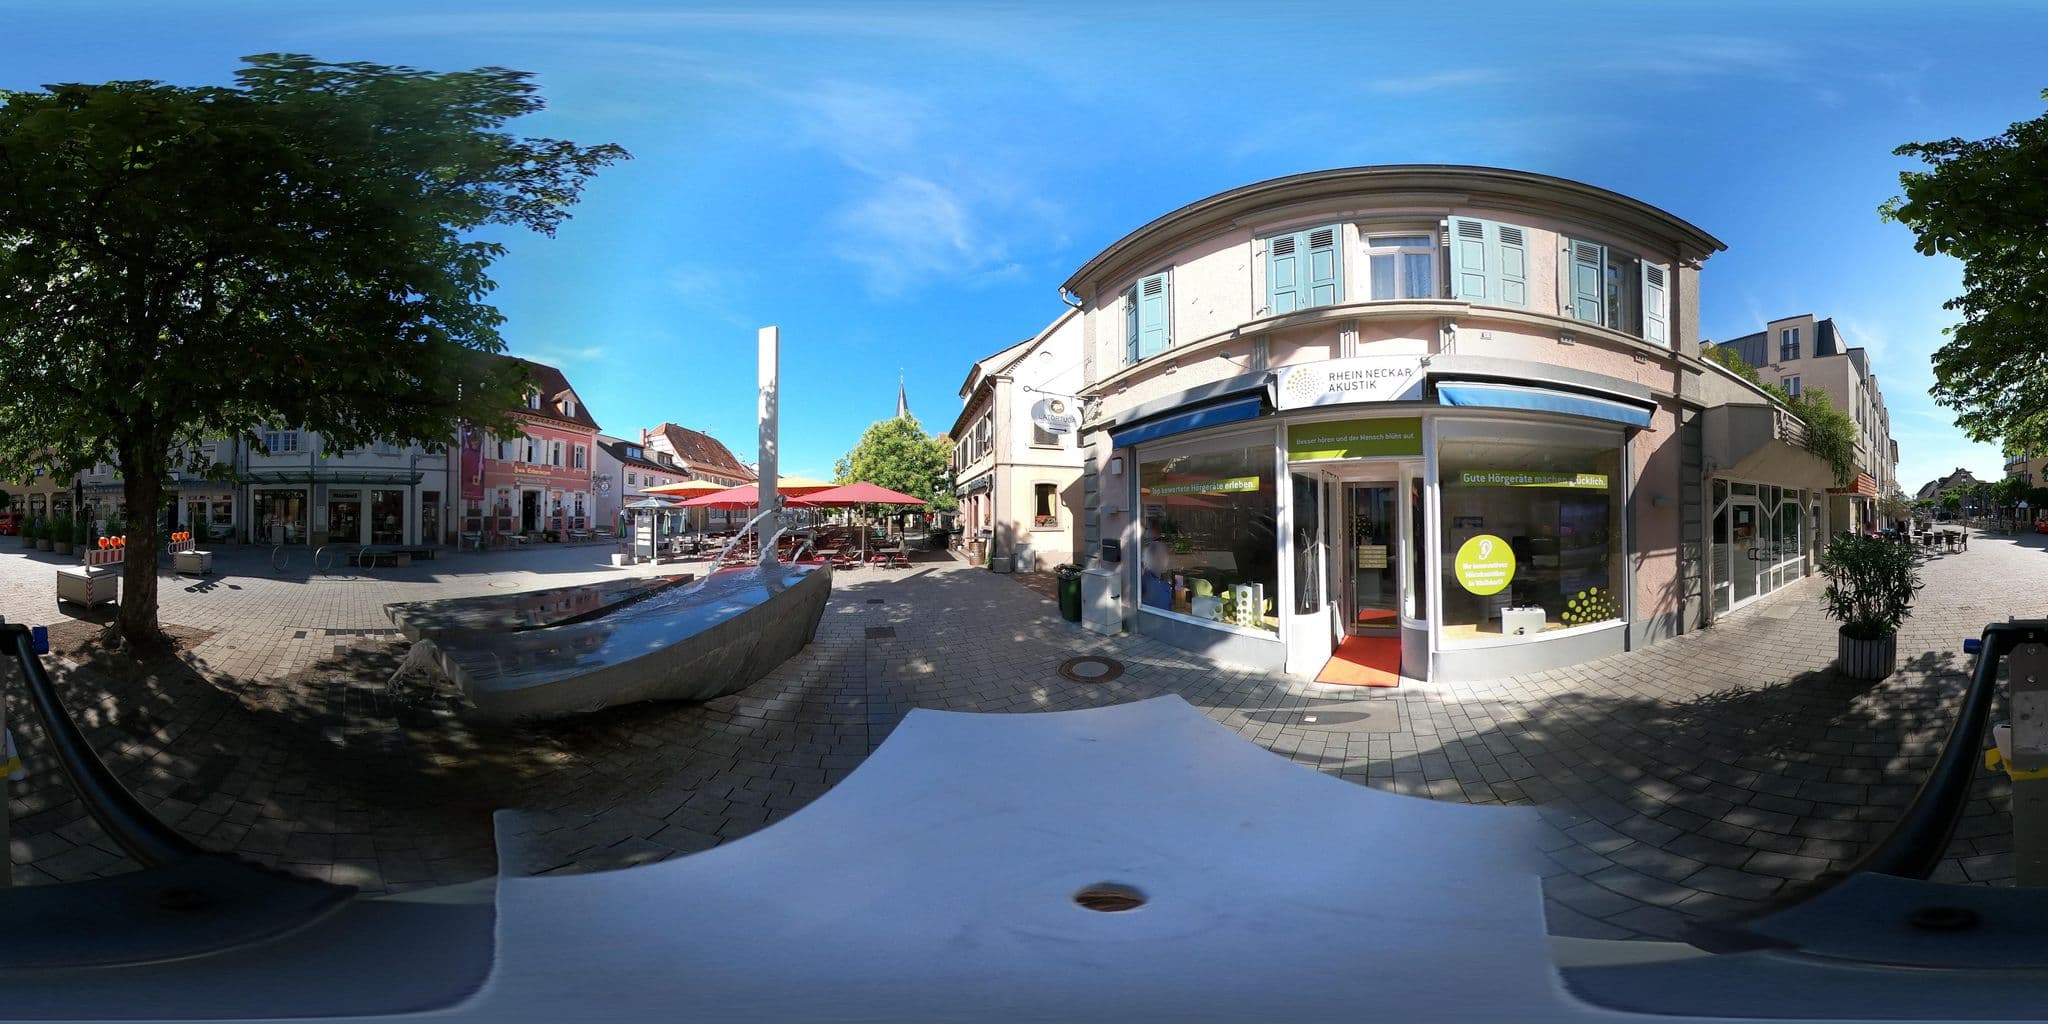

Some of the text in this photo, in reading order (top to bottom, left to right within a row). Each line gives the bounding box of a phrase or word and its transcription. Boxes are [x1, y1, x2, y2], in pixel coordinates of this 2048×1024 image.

[1328, 368, 1412, 381] RHEIN NECKAR
[1328, 380, 1377, 392] AKUSTIK
[1318, 436, 1335, 444] hören
[1360, 433, 1384, 441] Mensch
[1385, 432, 1402, 440] blüht
[1463, 473, 1486, 483] Gute
[1488, 472, 1533, 486] Hörgeräte
[1191, 483, 1224, 493] Hörgeräte
[1224, 480, 1256, 489] erleben.
